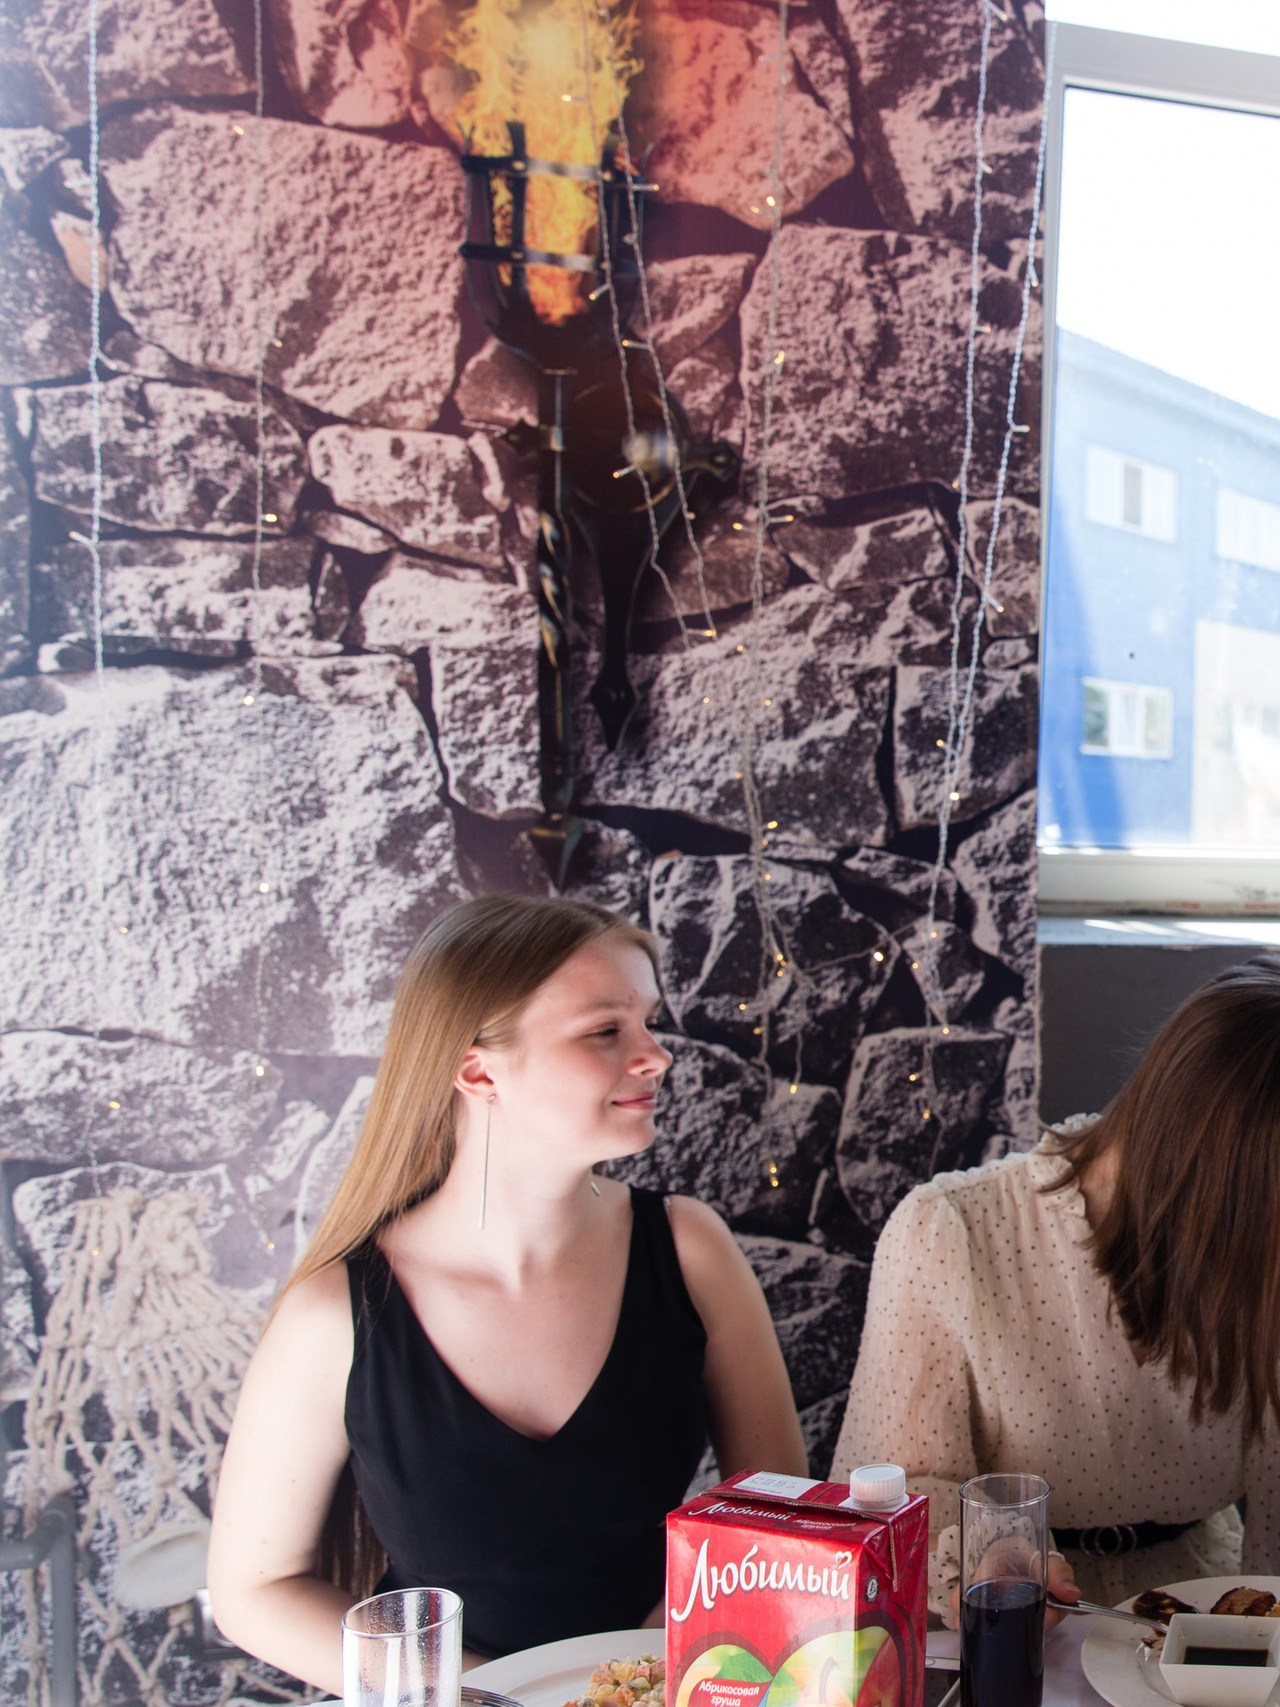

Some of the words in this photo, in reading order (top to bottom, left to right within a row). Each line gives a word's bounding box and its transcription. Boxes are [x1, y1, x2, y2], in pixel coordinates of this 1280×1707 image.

[689, 1501, 795, 1520] Любимый
[670, 1538, 852, 1622] Любимый
[698, 1680, 760, 1696] Абрикосовая
[711, 1695, 742, 1707] груша
